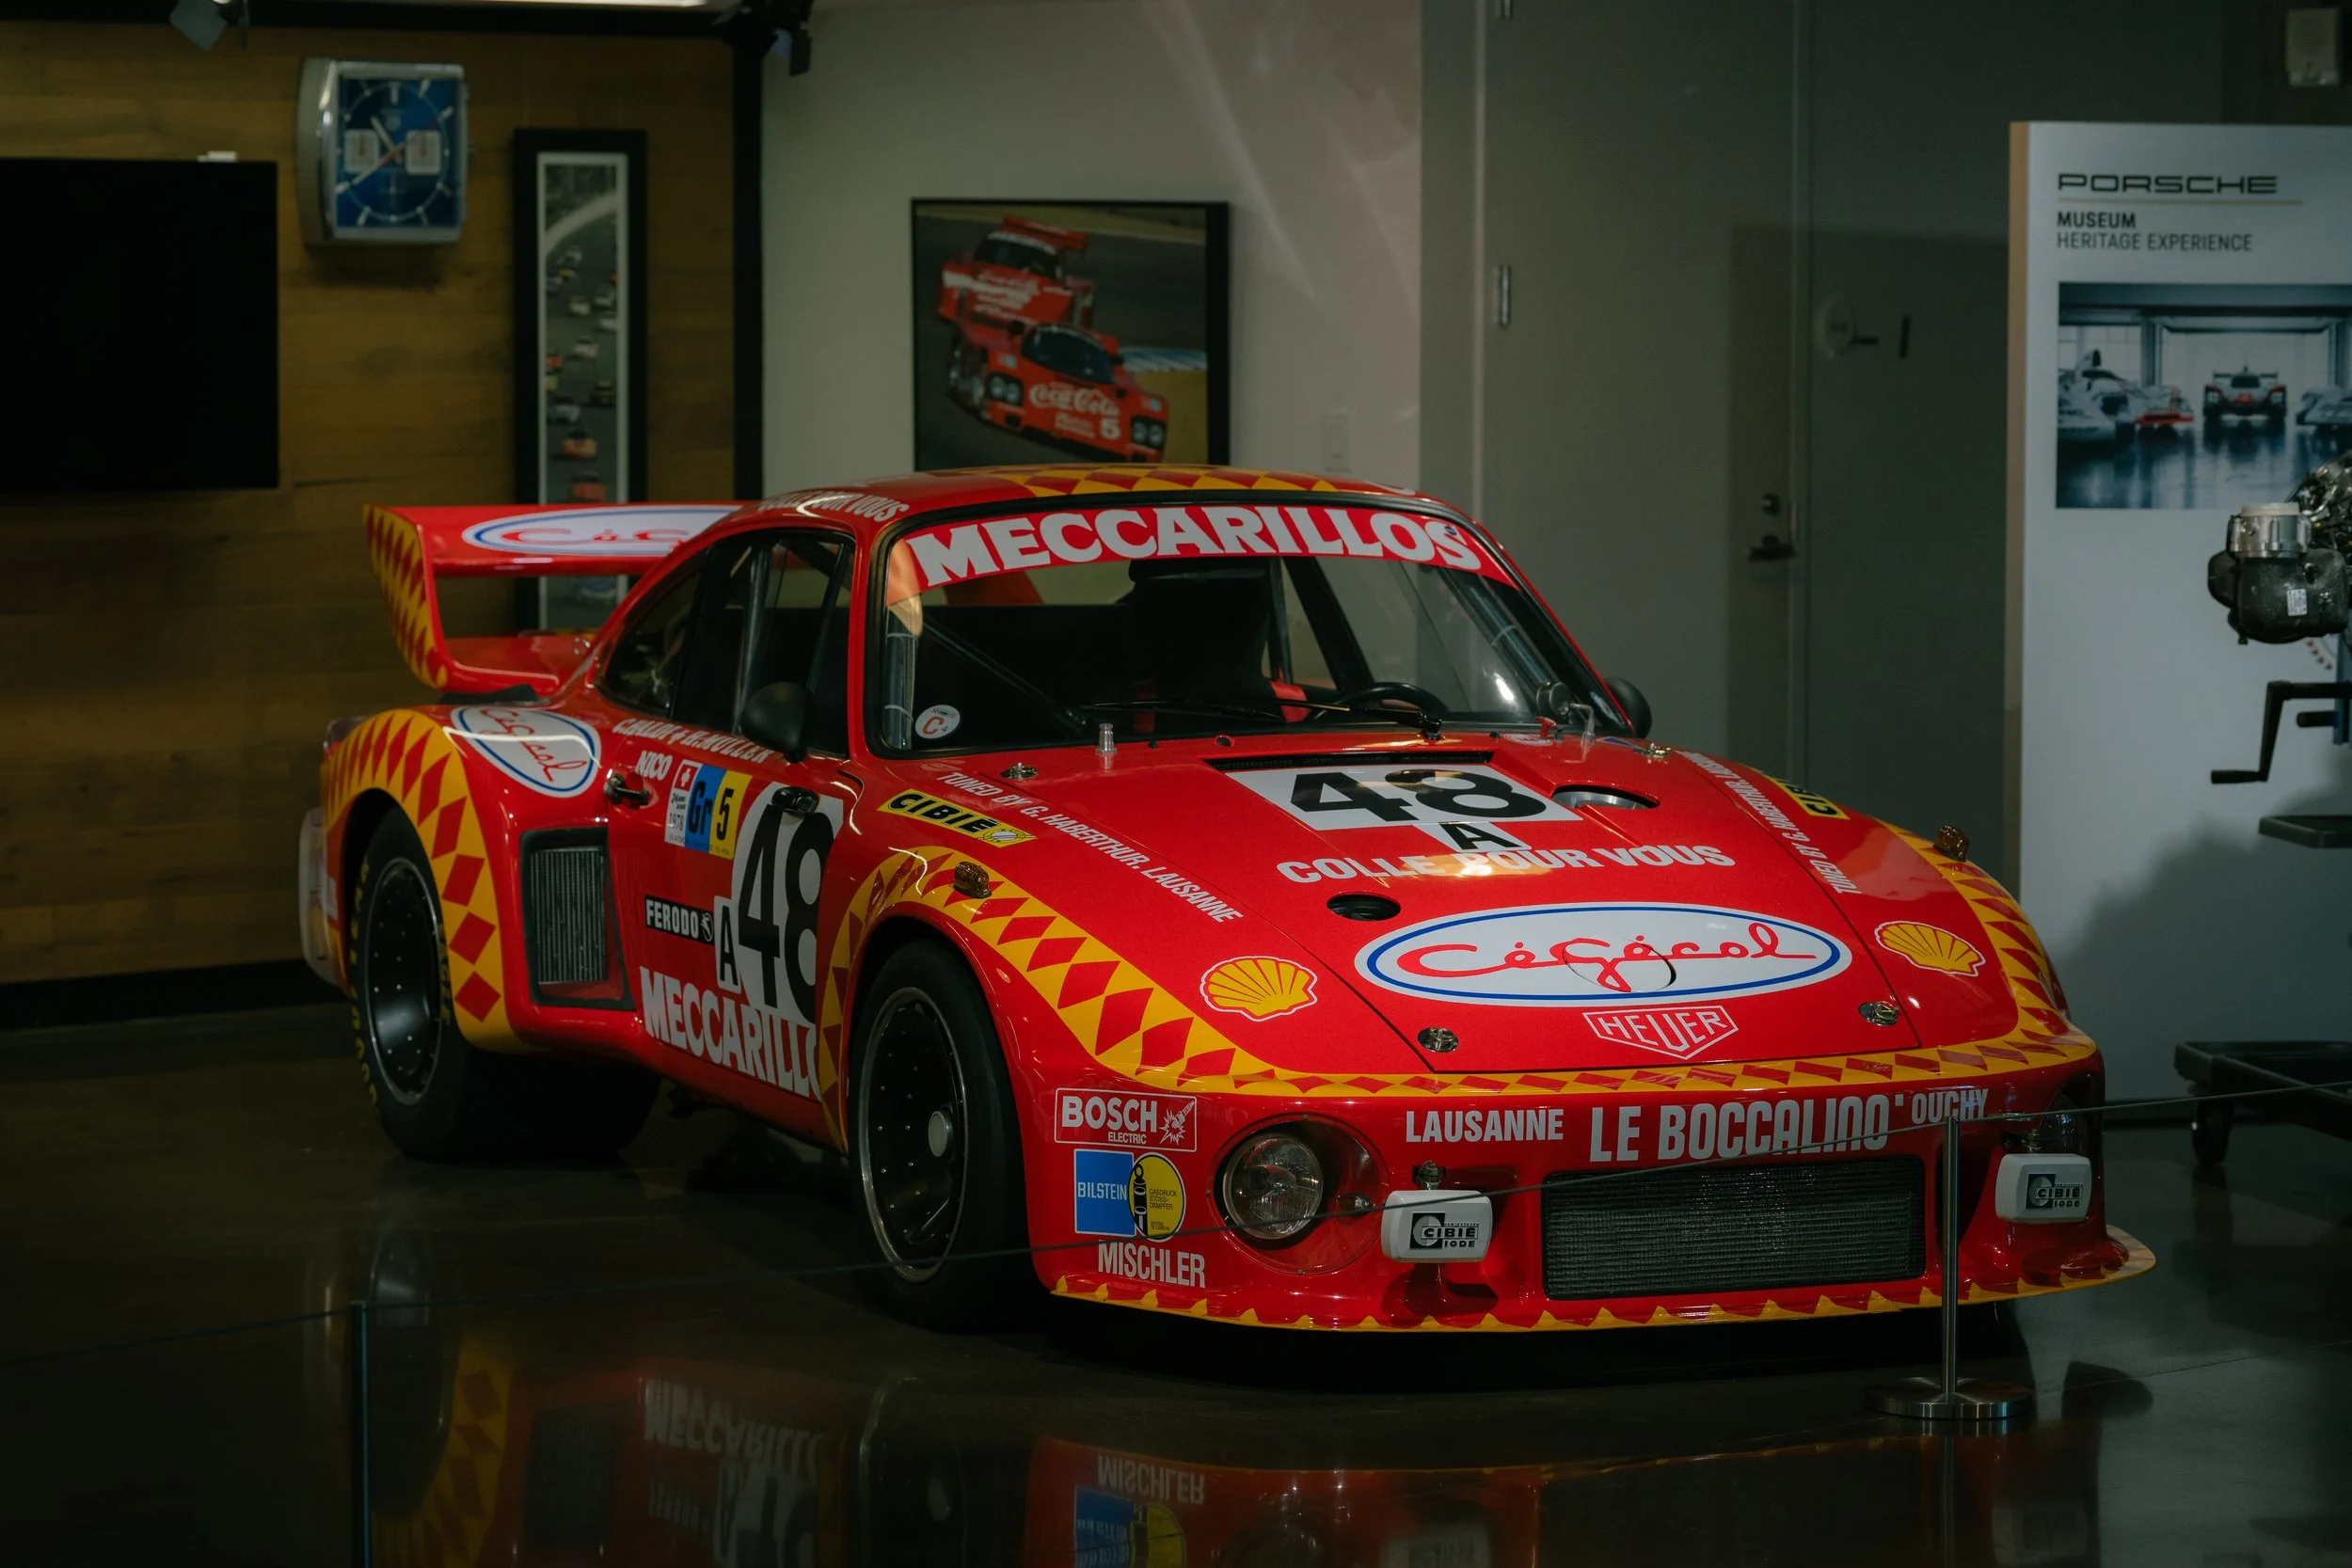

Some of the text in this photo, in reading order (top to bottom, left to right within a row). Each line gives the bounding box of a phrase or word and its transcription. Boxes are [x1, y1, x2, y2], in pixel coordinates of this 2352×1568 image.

[2058, 174, 2278, 194] PORSCHE
[2058, 212, 2137, 228] MUSEUM
[2058, 232, 2253, 252] HERITAGE EXPERIENCE
[907, 505, 1483, 588] MECCARILLOS
[635, 750, 674, 782] NICO
[716, 787, 735, 841] 5
[1290, 768, 1547, 822] 48
[937, 771, 1003, 797] TUNED
[991, 794, 1033, 806] BY
[1140, 865, 1244, 923] LAUSANNE
[1438, 822, 1521, 849] A
[1277, 849, 1437, 883] COLLE
[1592, 845, 1736, 866] VOUS
[645, 898, 699, 940] FERODO
[739, 803, 834, 1024] 48
[1597, 1011, 1725, 1053] HEUER
[1062, 1096, 1158, 1132] BOSCH
[1406, 1108, 1565, 1143] LAUSANNE
[1589, 1106, 1643, 1163] LE
[1911, 1088, 1989, 1125] OUCHY
[1108, 1132, 1147, 1145] ELECTRIC
[1077, 1181, 1128, 1201] BILSTEIN
[1444, 1240, 1475, 1248] IODE
[1098, 1239, 1206, 1289] MISCHLER
